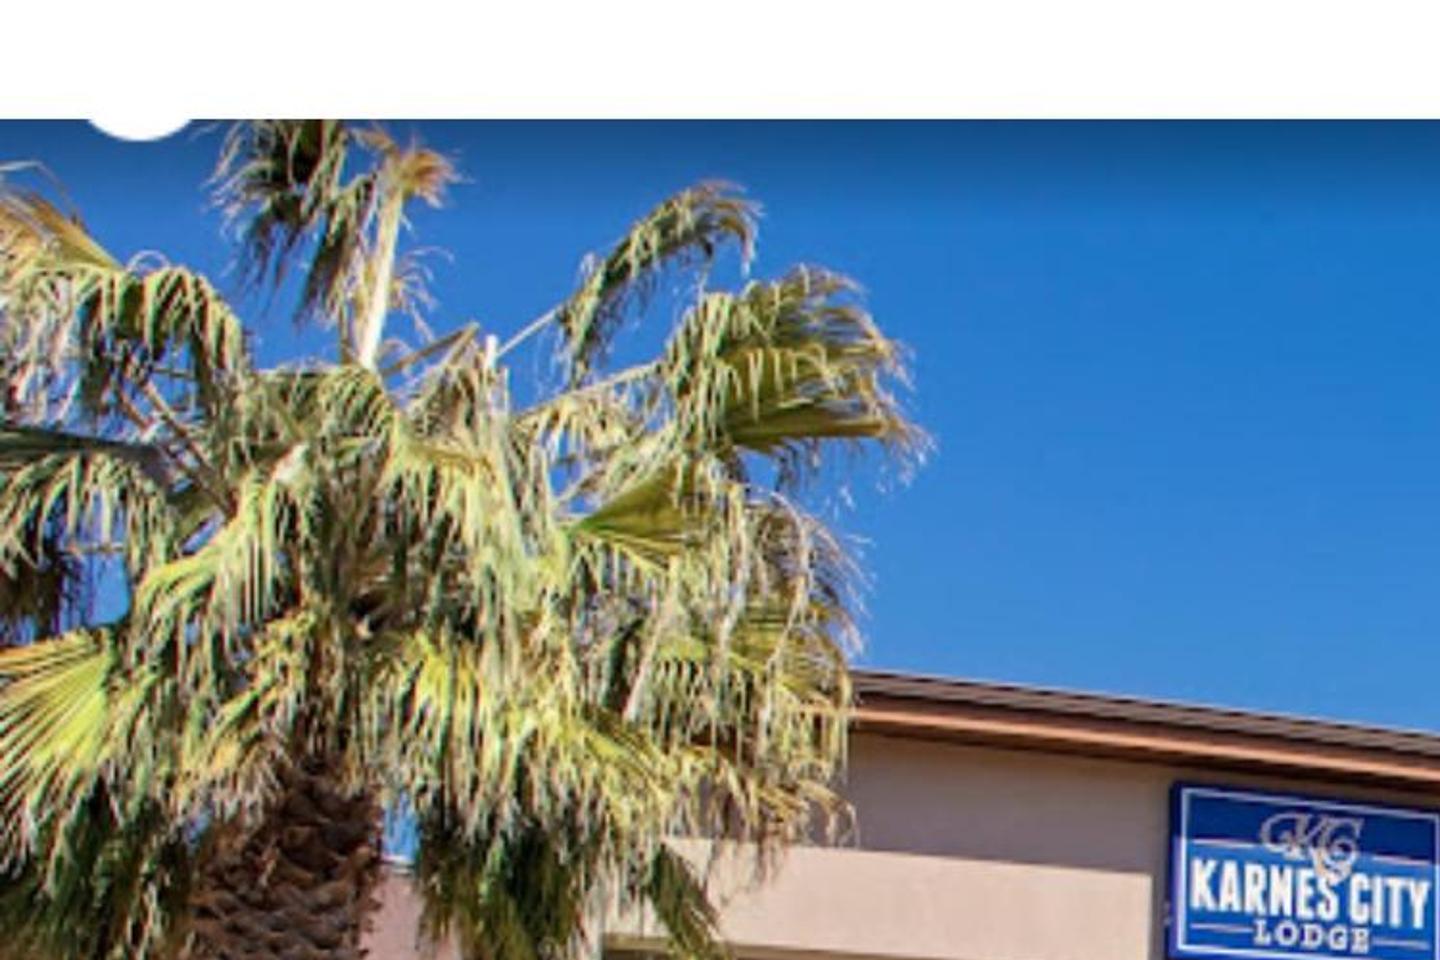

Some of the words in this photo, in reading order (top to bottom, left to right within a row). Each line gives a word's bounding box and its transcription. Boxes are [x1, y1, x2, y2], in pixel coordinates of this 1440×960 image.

[1190, 857, 1340, 920] KARNES
[1350, 872, 1431, 930] CITY
[1253, 918, 1370, 954] LODGE
